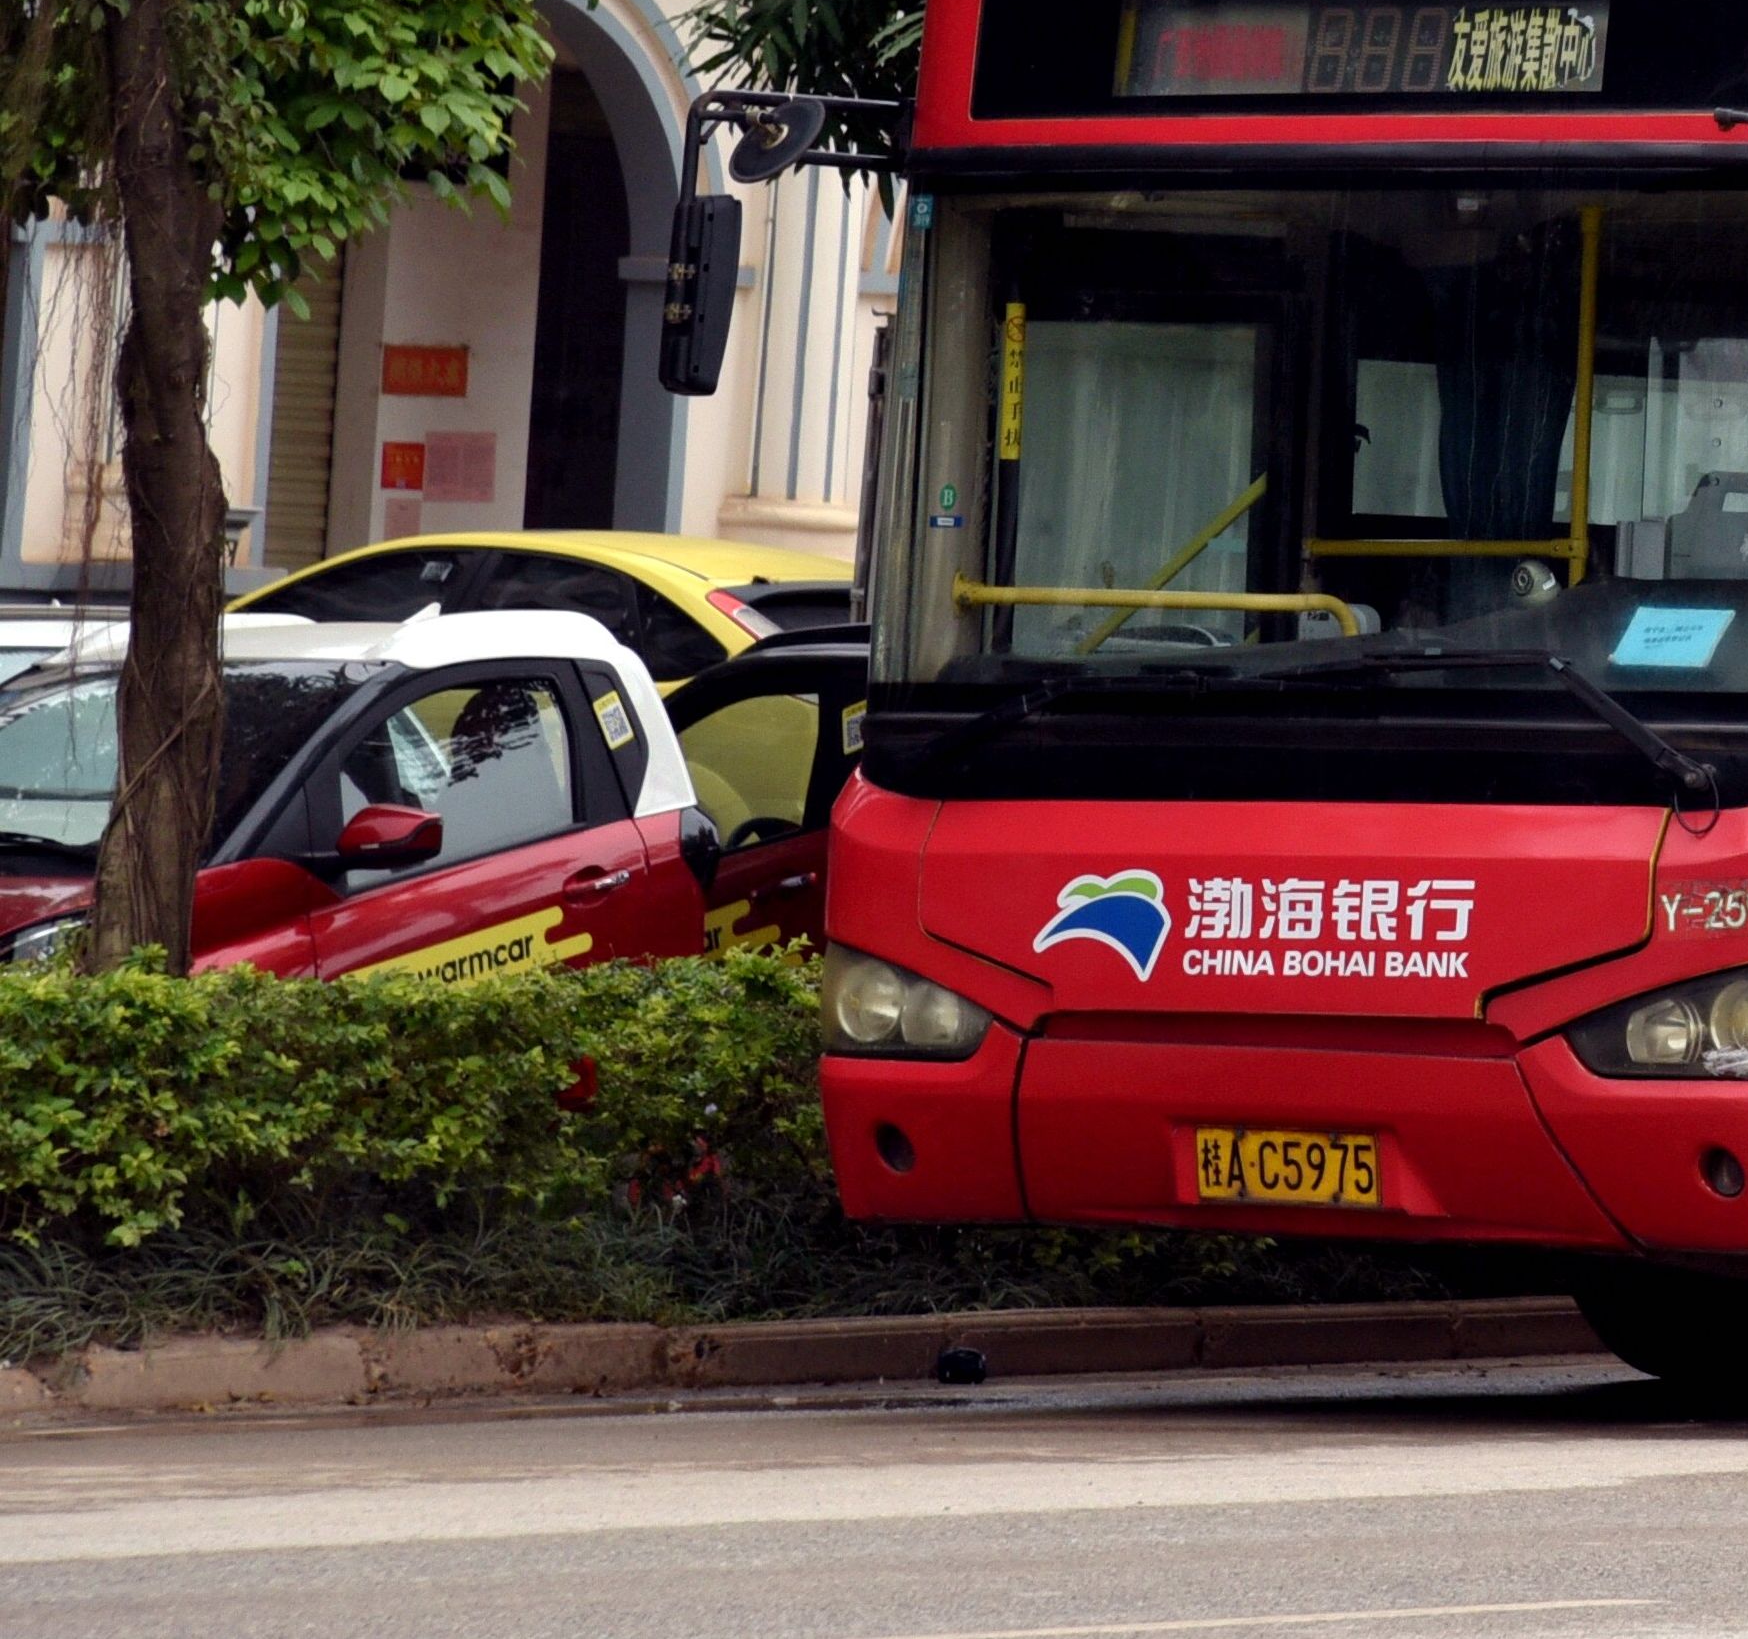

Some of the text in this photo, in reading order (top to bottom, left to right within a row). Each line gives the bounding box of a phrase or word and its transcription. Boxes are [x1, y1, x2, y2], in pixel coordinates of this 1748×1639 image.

[1184, 877, 1476, 941] 渤海银行
[1182, 949, 1469, 978] CHINA BOHAI BANK
